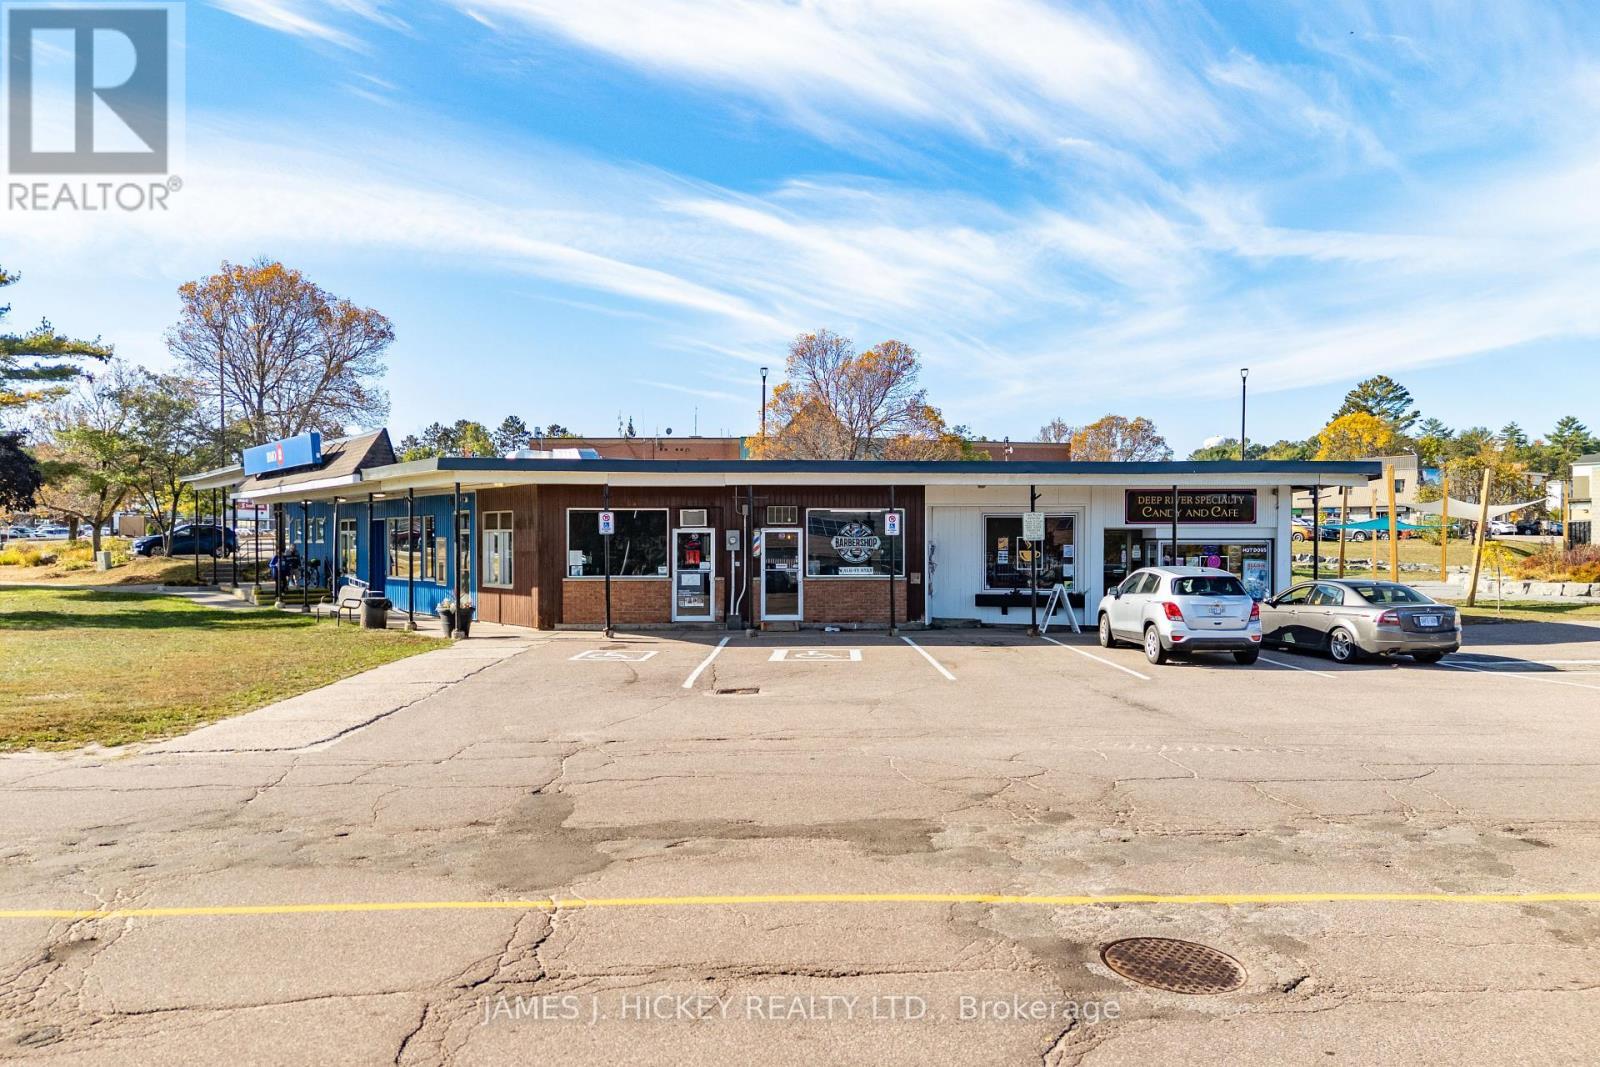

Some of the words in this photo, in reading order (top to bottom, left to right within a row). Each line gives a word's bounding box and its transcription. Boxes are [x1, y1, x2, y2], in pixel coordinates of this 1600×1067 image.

[1138, 496, 1164, 505] DEEP
[1194, 495, 1245, 505] SPECIALTY
[1185, 508, 1209, 517] AND
[1211, 506, 1239, 517] CAFE
[835, 537, 878, 548] BARBERSHOP
